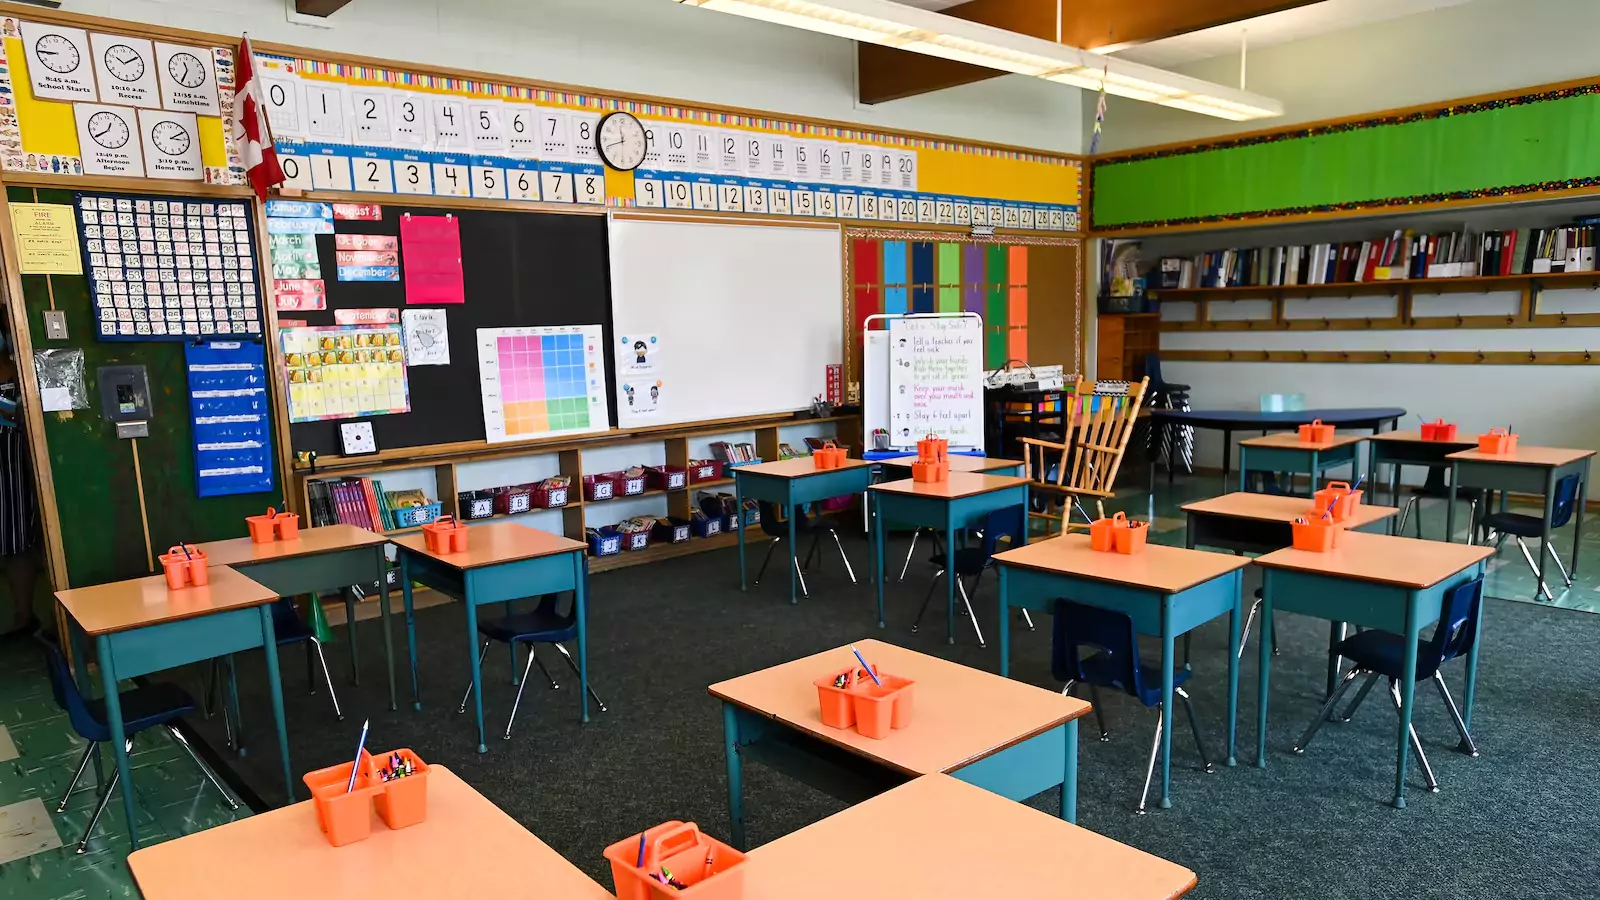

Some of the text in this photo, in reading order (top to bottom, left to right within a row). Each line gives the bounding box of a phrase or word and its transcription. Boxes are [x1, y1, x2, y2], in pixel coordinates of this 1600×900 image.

[38, 82, 91, 93] School Starts
[270, 84, 285, 106] 0
[118, 92, 142, 100] Recess
[173, 98, 210, 107] Lunchtime
[363, 98, 378, 119] 2
[402, 102, 415, 122] 3
[443, 106, 454, 126] 4
[479, 110, 491, 130] 5
[513, 114, 525, 133] 6
[547, 118, 557, 136] 7
[579, 121, 590, 140] 8
[644, 129, 655, 147] 9
[668, 131, 683, 149] 10
[698, 134, 707, 152] 11
[723, 137, 735, 154] 12
[748, 139, 760, 157] 13
[772, 143, 783, 159] 14
[796, 146, 807, 162] 15
[819, 148, 831, 164] 16
[841, 151, 850, 165] 17
[861, 153, 872, 169] 18
[881, 155, 891, 169] 19
[283, 158, 299, 179] 0
[367, 161, 380, 182] 2
[899, 158, 913, 173] 20
[406, 164, 419, 184] 3
[445, 167, 457, 187] 4
[483, 170, 495, 189] 5
[517, 172, 529, 191] 6
[552, 175, 562, 193] 7
[585, 176, 595, 195] 8
[644, 181, 654, 199] 9
[670, 183, 687, 200] 10
[699, 185, 712, 202] 11
[724, 187, 738, 204] 12
[749, 188, 763, 206] 13
[773, 191, 786, 207] 14
[797, 192, 810, 208] 15
[268, 201, 311, 215] January
[819, 194, 831, 210] 16
[841, 196, 853, 211] 17
[863, 197, 874, 212] 18
[883, 199, 893, 214] 19
[901, 201, 915, 216] 20
[922, 202, 932, 217] 21
[34, 211, 52, 219] FIRE
[334, 204, 370, 217] August
[939, 203, 952, 218] 22
[957, 205, 969, 219] 23
[973, 206, 985, 220] 24
[991, 207, 1002, 221] 25
[1006, 208, 1017, 223] 26
[1022, 210, 1033, 224] 27
[1038, 211, 1048, 225] 28
[269, 219, 317, 232] February
[1052, 212, 1062, 225] 29
[1065, 213, 1076, 226] 30
[269, 234, 302, 246] March
[274, 250, 299, 263] April
[338, 251, 385, 263] November
[275, 264, 300, 277] May
[339, 267, 387, 278] December
[277, 282, 301, 292] June
[278, 297, 299, 308] July
[963, 339, 973, 347] you
[913, 409, 929, 422] Stay
[953, 409, 972, 422] apart
[600, 486, 608, 495] G
[631, 481, 638, 490] H
[517, 498, 523, 508] B
[555, 493, 561, 502] C
[479, 504, 486, 512] A
[637, 537, 643, 546] K
